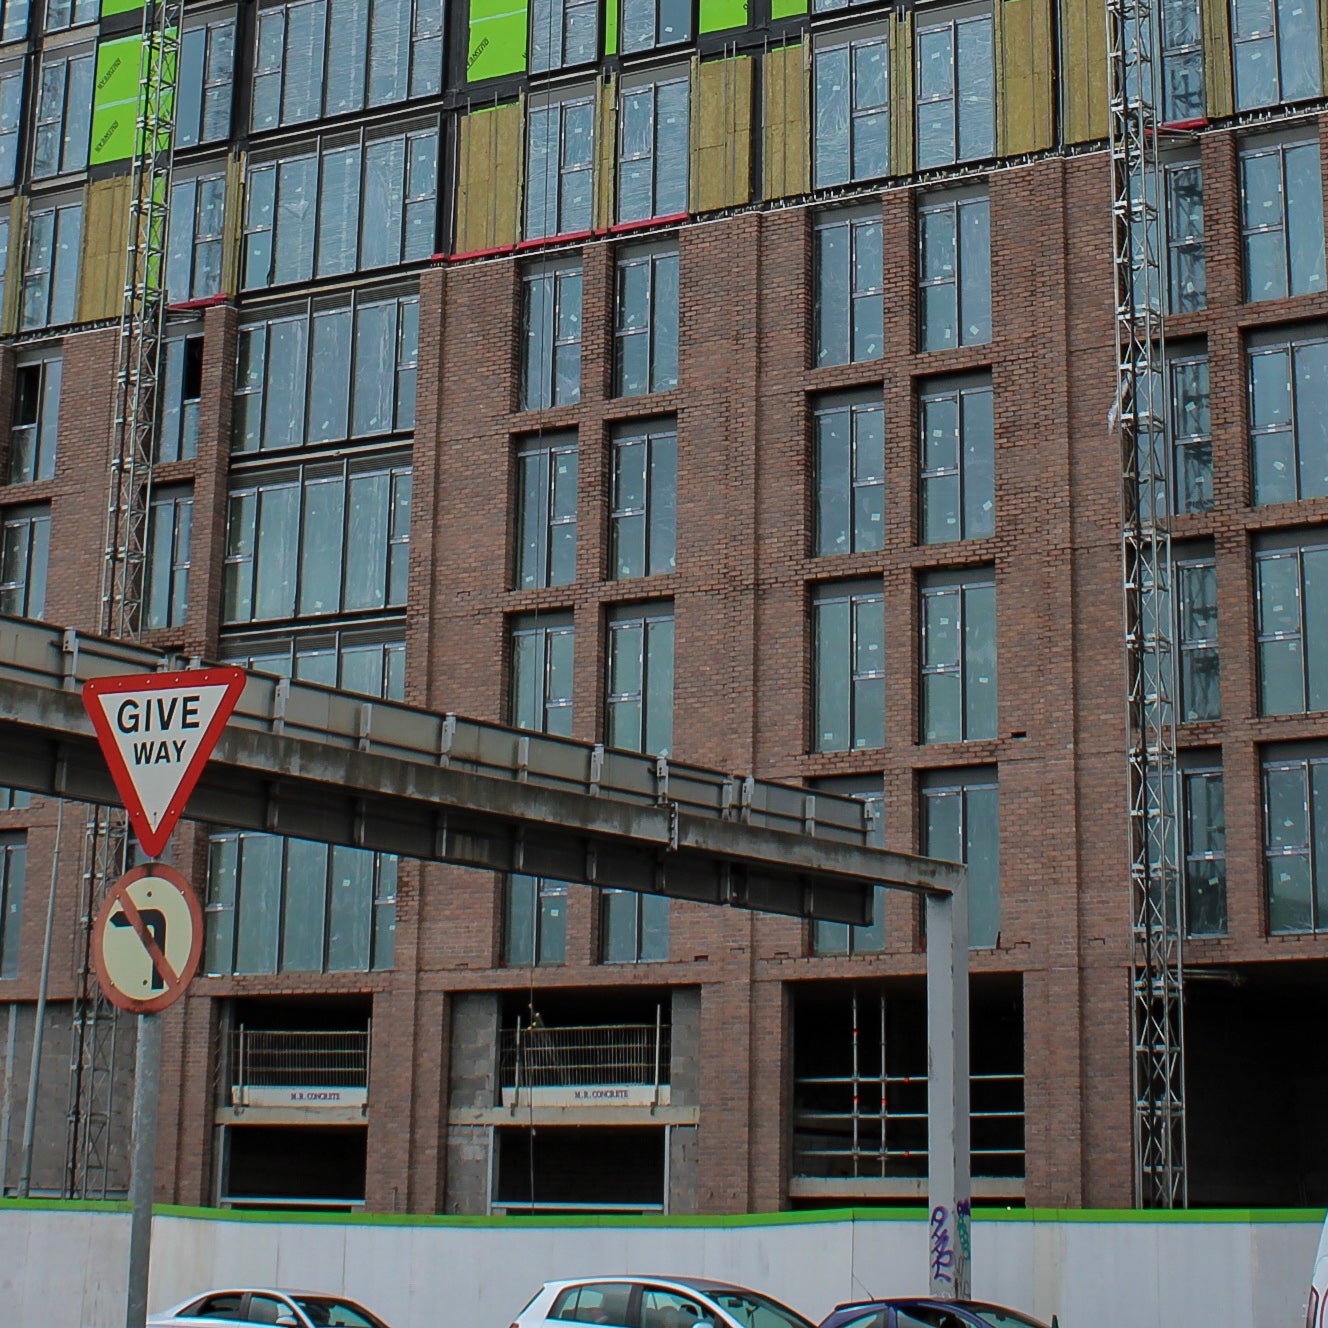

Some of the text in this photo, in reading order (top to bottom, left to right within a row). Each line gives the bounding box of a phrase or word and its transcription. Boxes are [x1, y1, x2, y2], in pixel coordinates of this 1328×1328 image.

[117, 695, 201, 733] GIVE
[133, 739, 187, 765] WAY
[591, 1089, 629, 1099] CONCRETE
